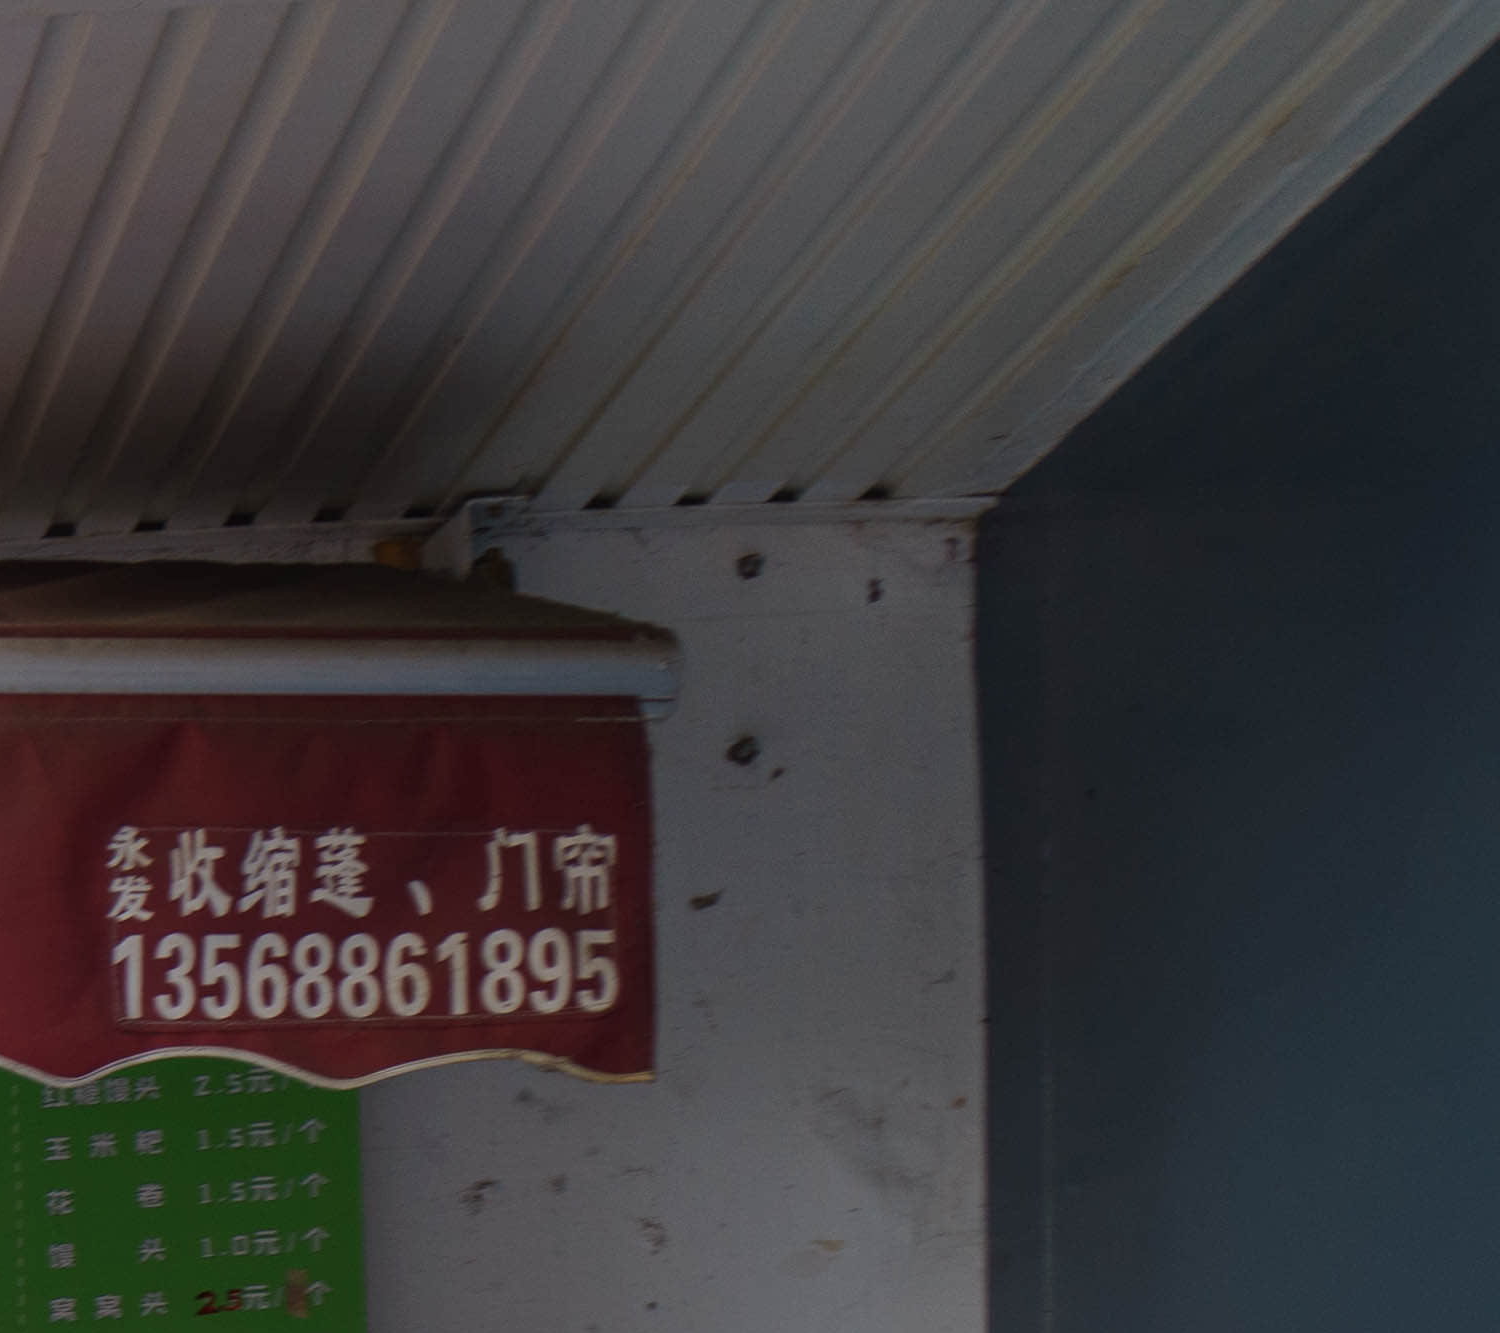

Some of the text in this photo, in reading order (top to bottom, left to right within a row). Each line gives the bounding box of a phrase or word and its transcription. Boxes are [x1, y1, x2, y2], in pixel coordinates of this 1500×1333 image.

[106, 826, 155, 922] 永发
[112, 929, 619, 1020] 13568861895
[193, 1067, 317, 1097] 2.5元/
[46, 1184, 165, 1215] 花卷
[47, 1238, 167, 1269] 馒头
